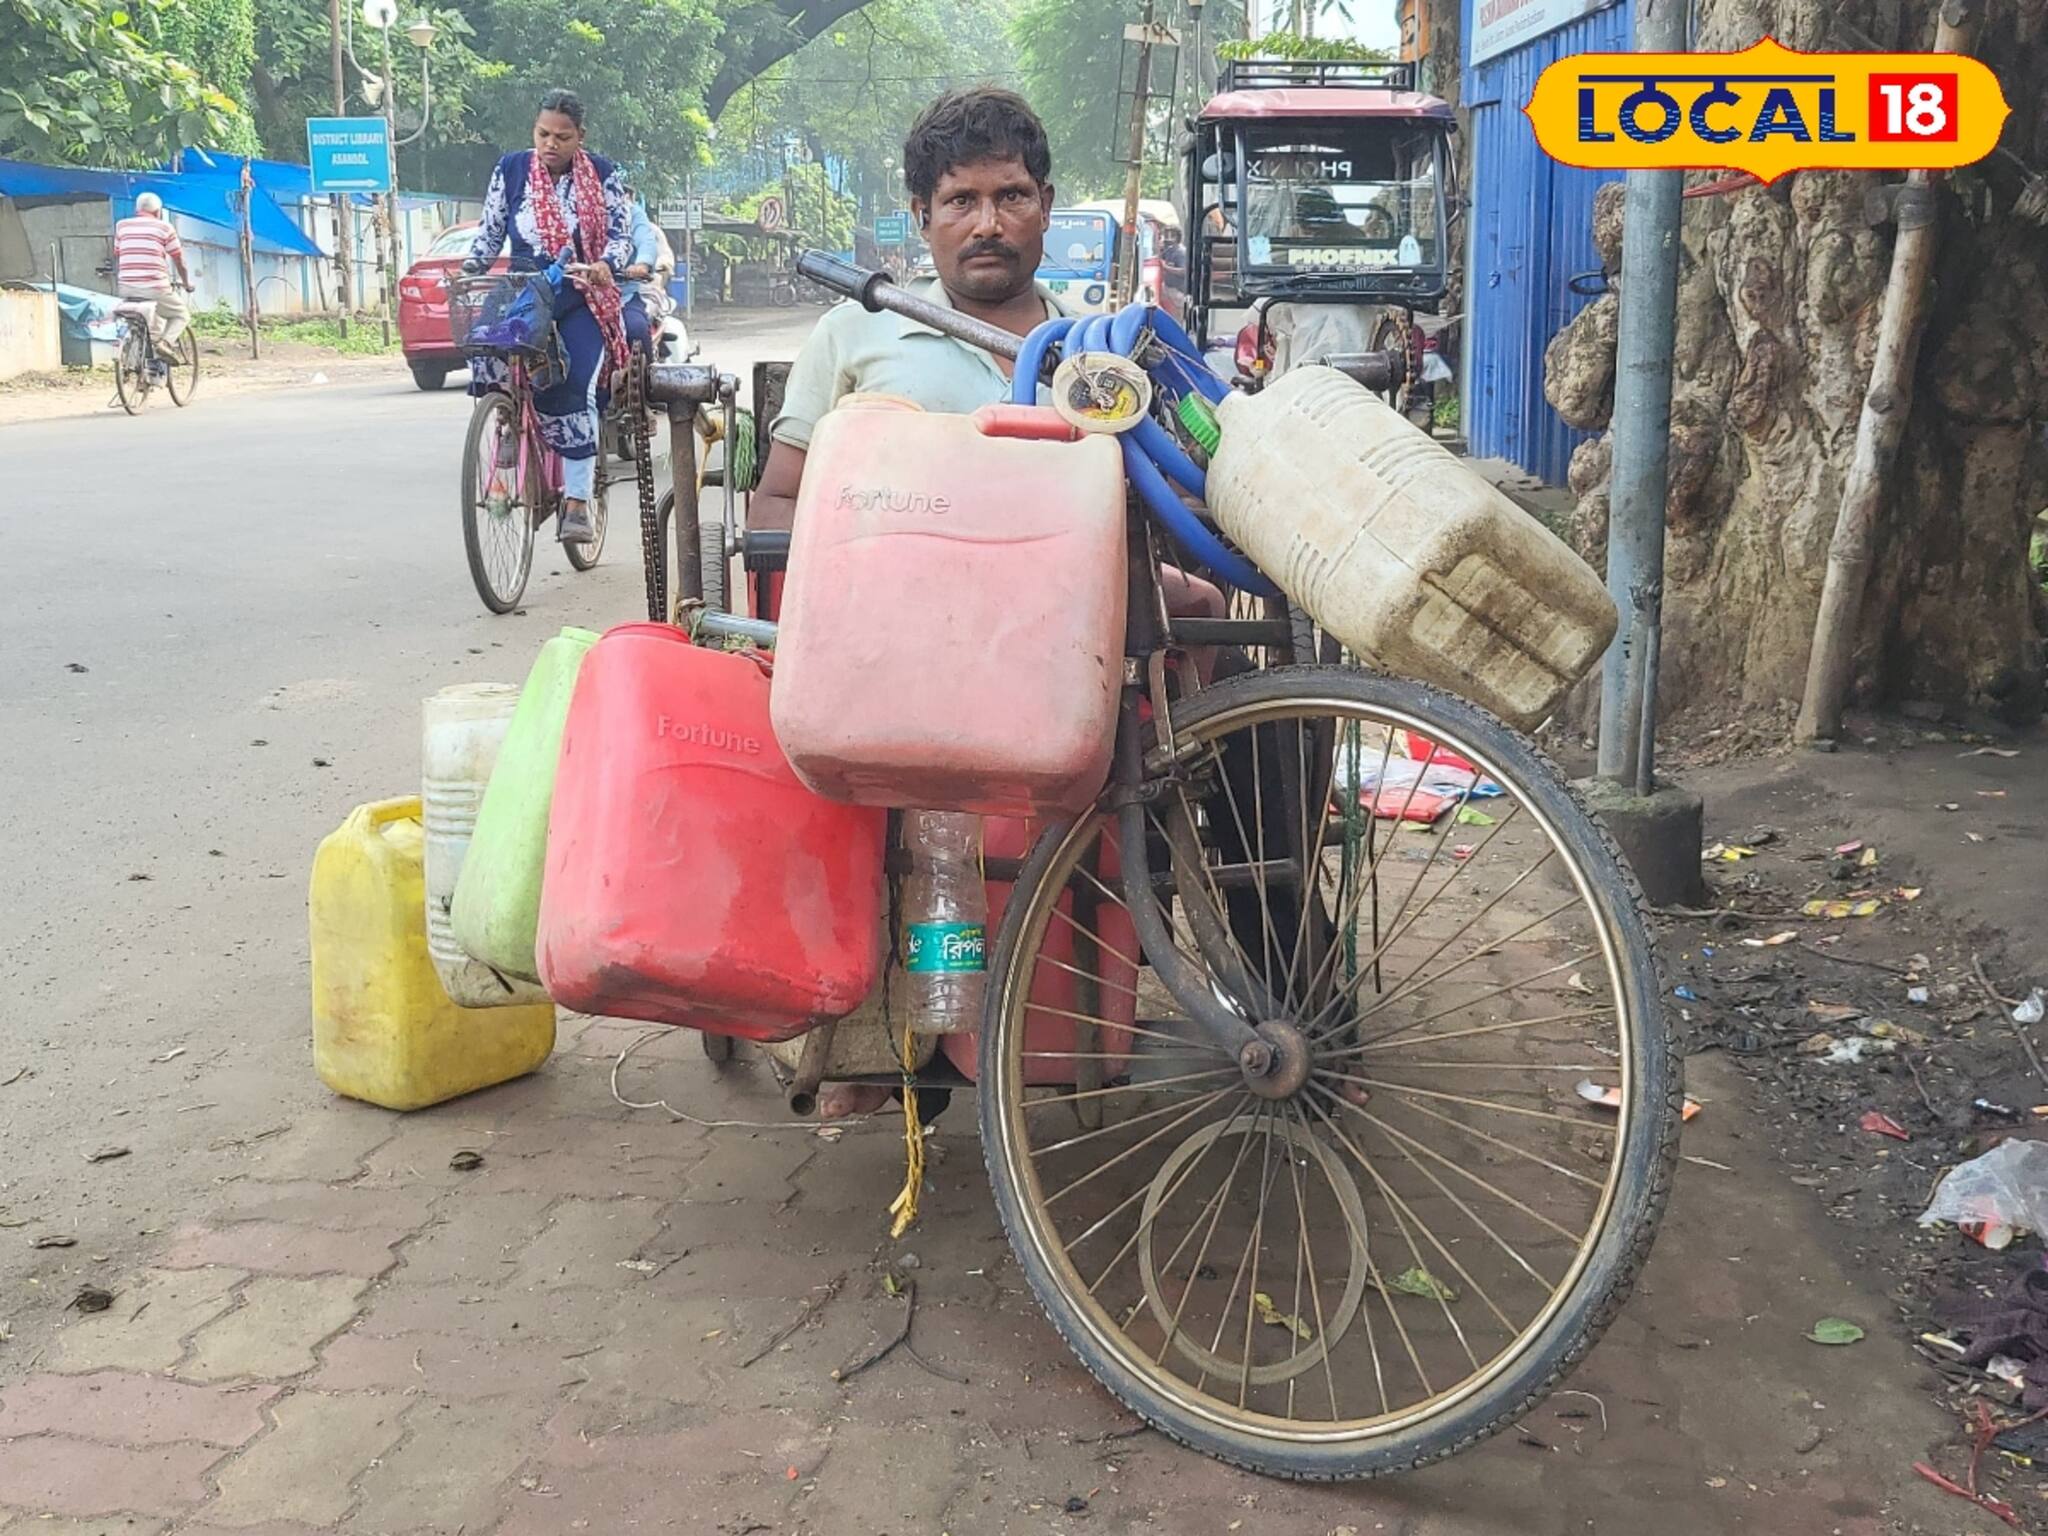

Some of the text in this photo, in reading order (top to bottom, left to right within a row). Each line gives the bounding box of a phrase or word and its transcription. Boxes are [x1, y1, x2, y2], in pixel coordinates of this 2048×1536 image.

[312, 133, 384, 145] DISTRICT LIBRARY
[1288, 249, 1399, 265] PHOENIX
[834, 485, 951, 514] Fortune
[657, 714, 761, 755] Fortune
